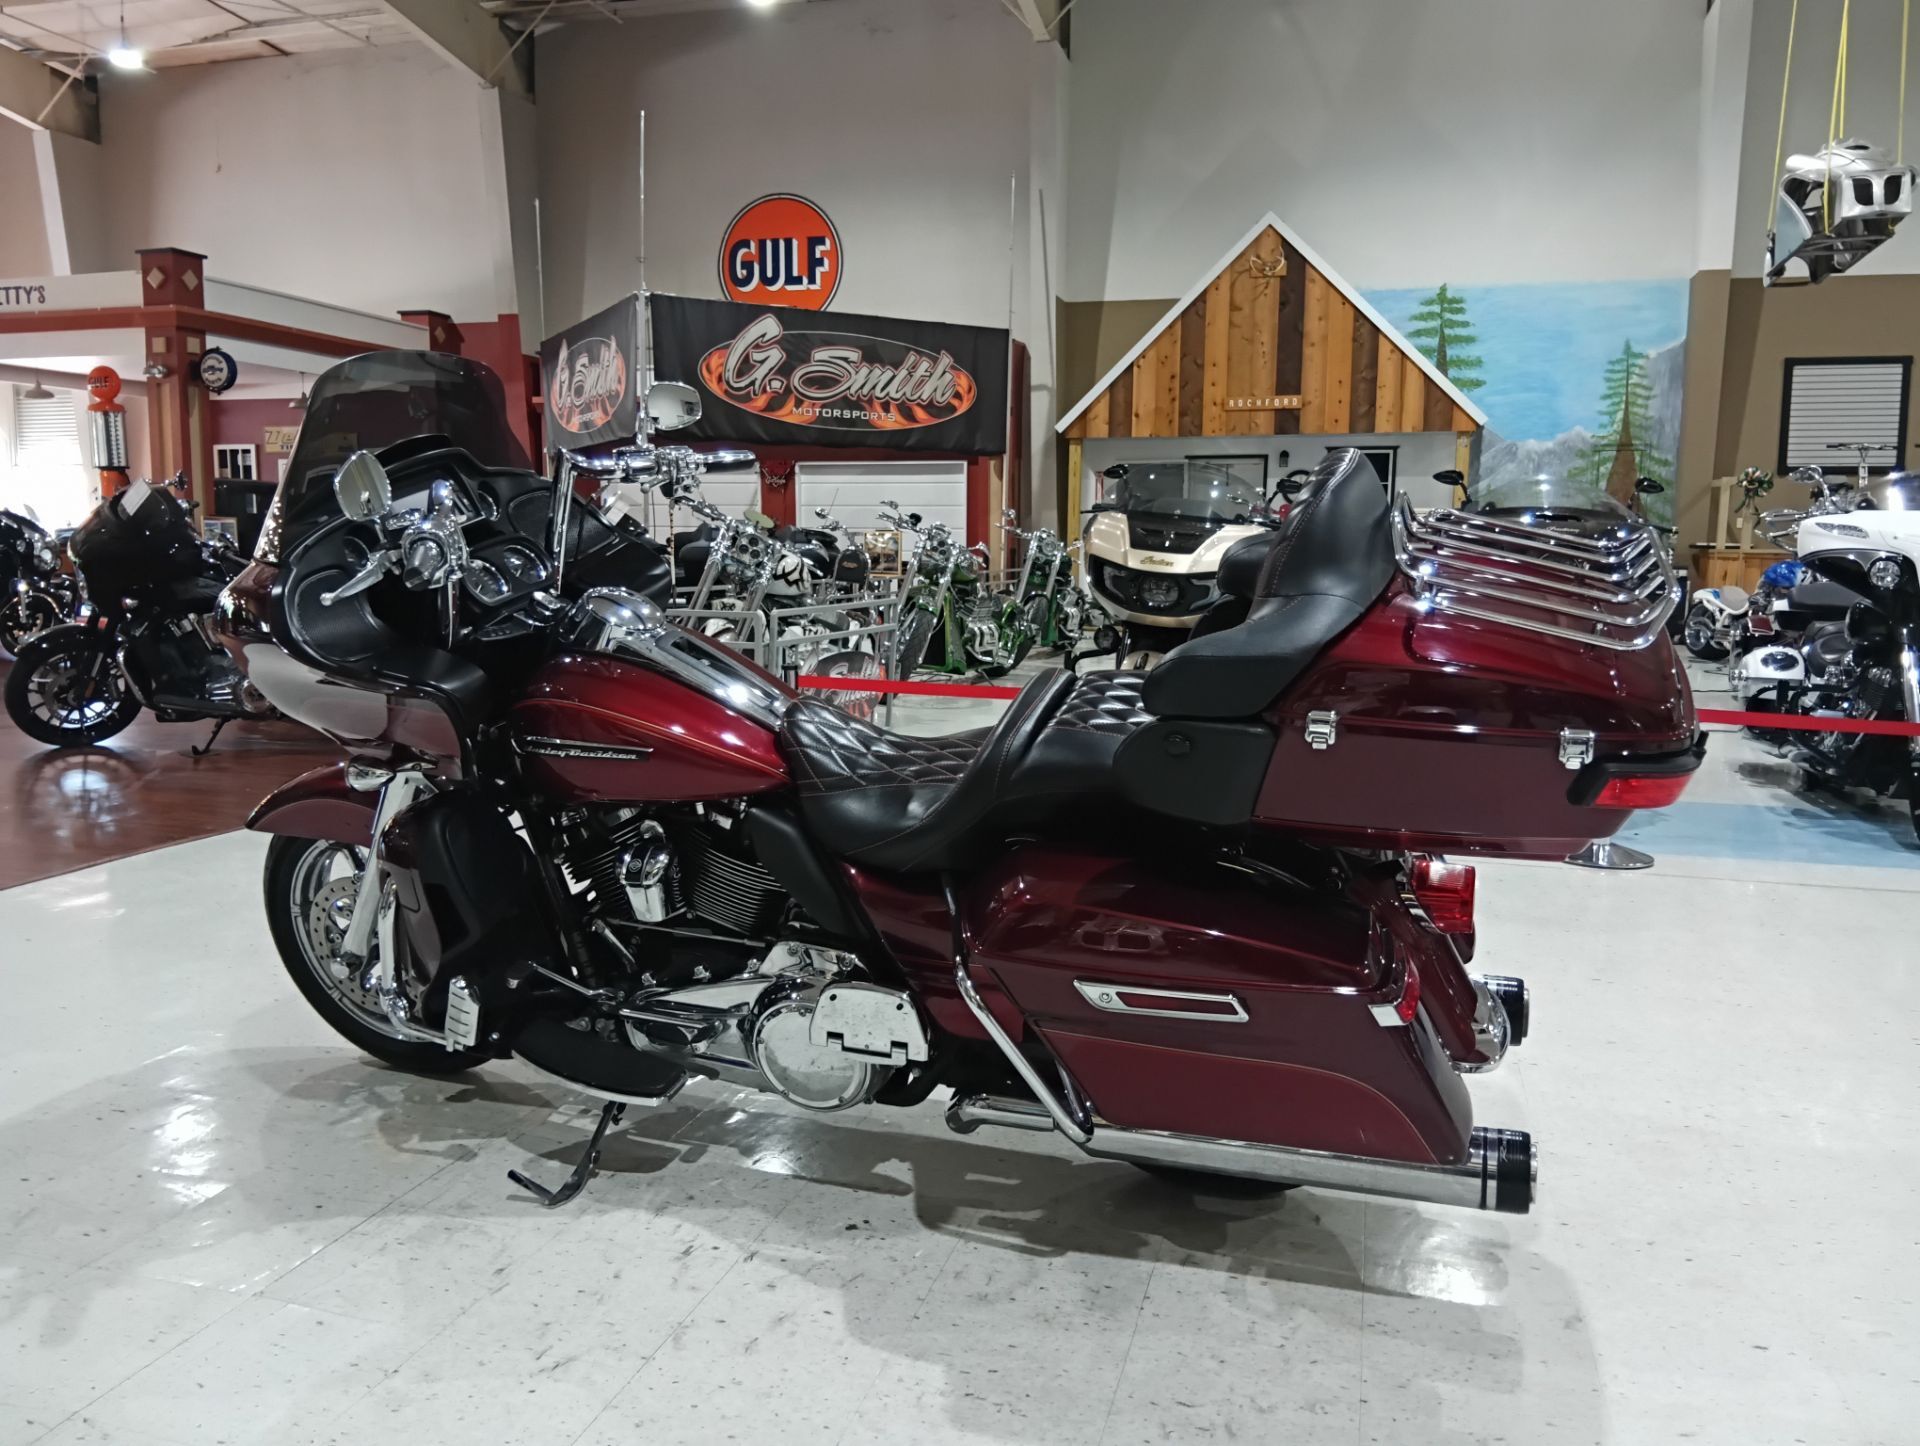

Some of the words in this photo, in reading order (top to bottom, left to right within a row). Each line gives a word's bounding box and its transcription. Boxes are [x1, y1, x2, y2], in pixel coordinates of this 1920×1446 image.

[729, 236, 830, 292] GULF
[724, 313, 786, 398] G.
[791, 346, 957, 405] Smith
[792, 406, 897, 422] MOTORSPORTS
[1228, 397, 1298, 408] ROCHFORD
